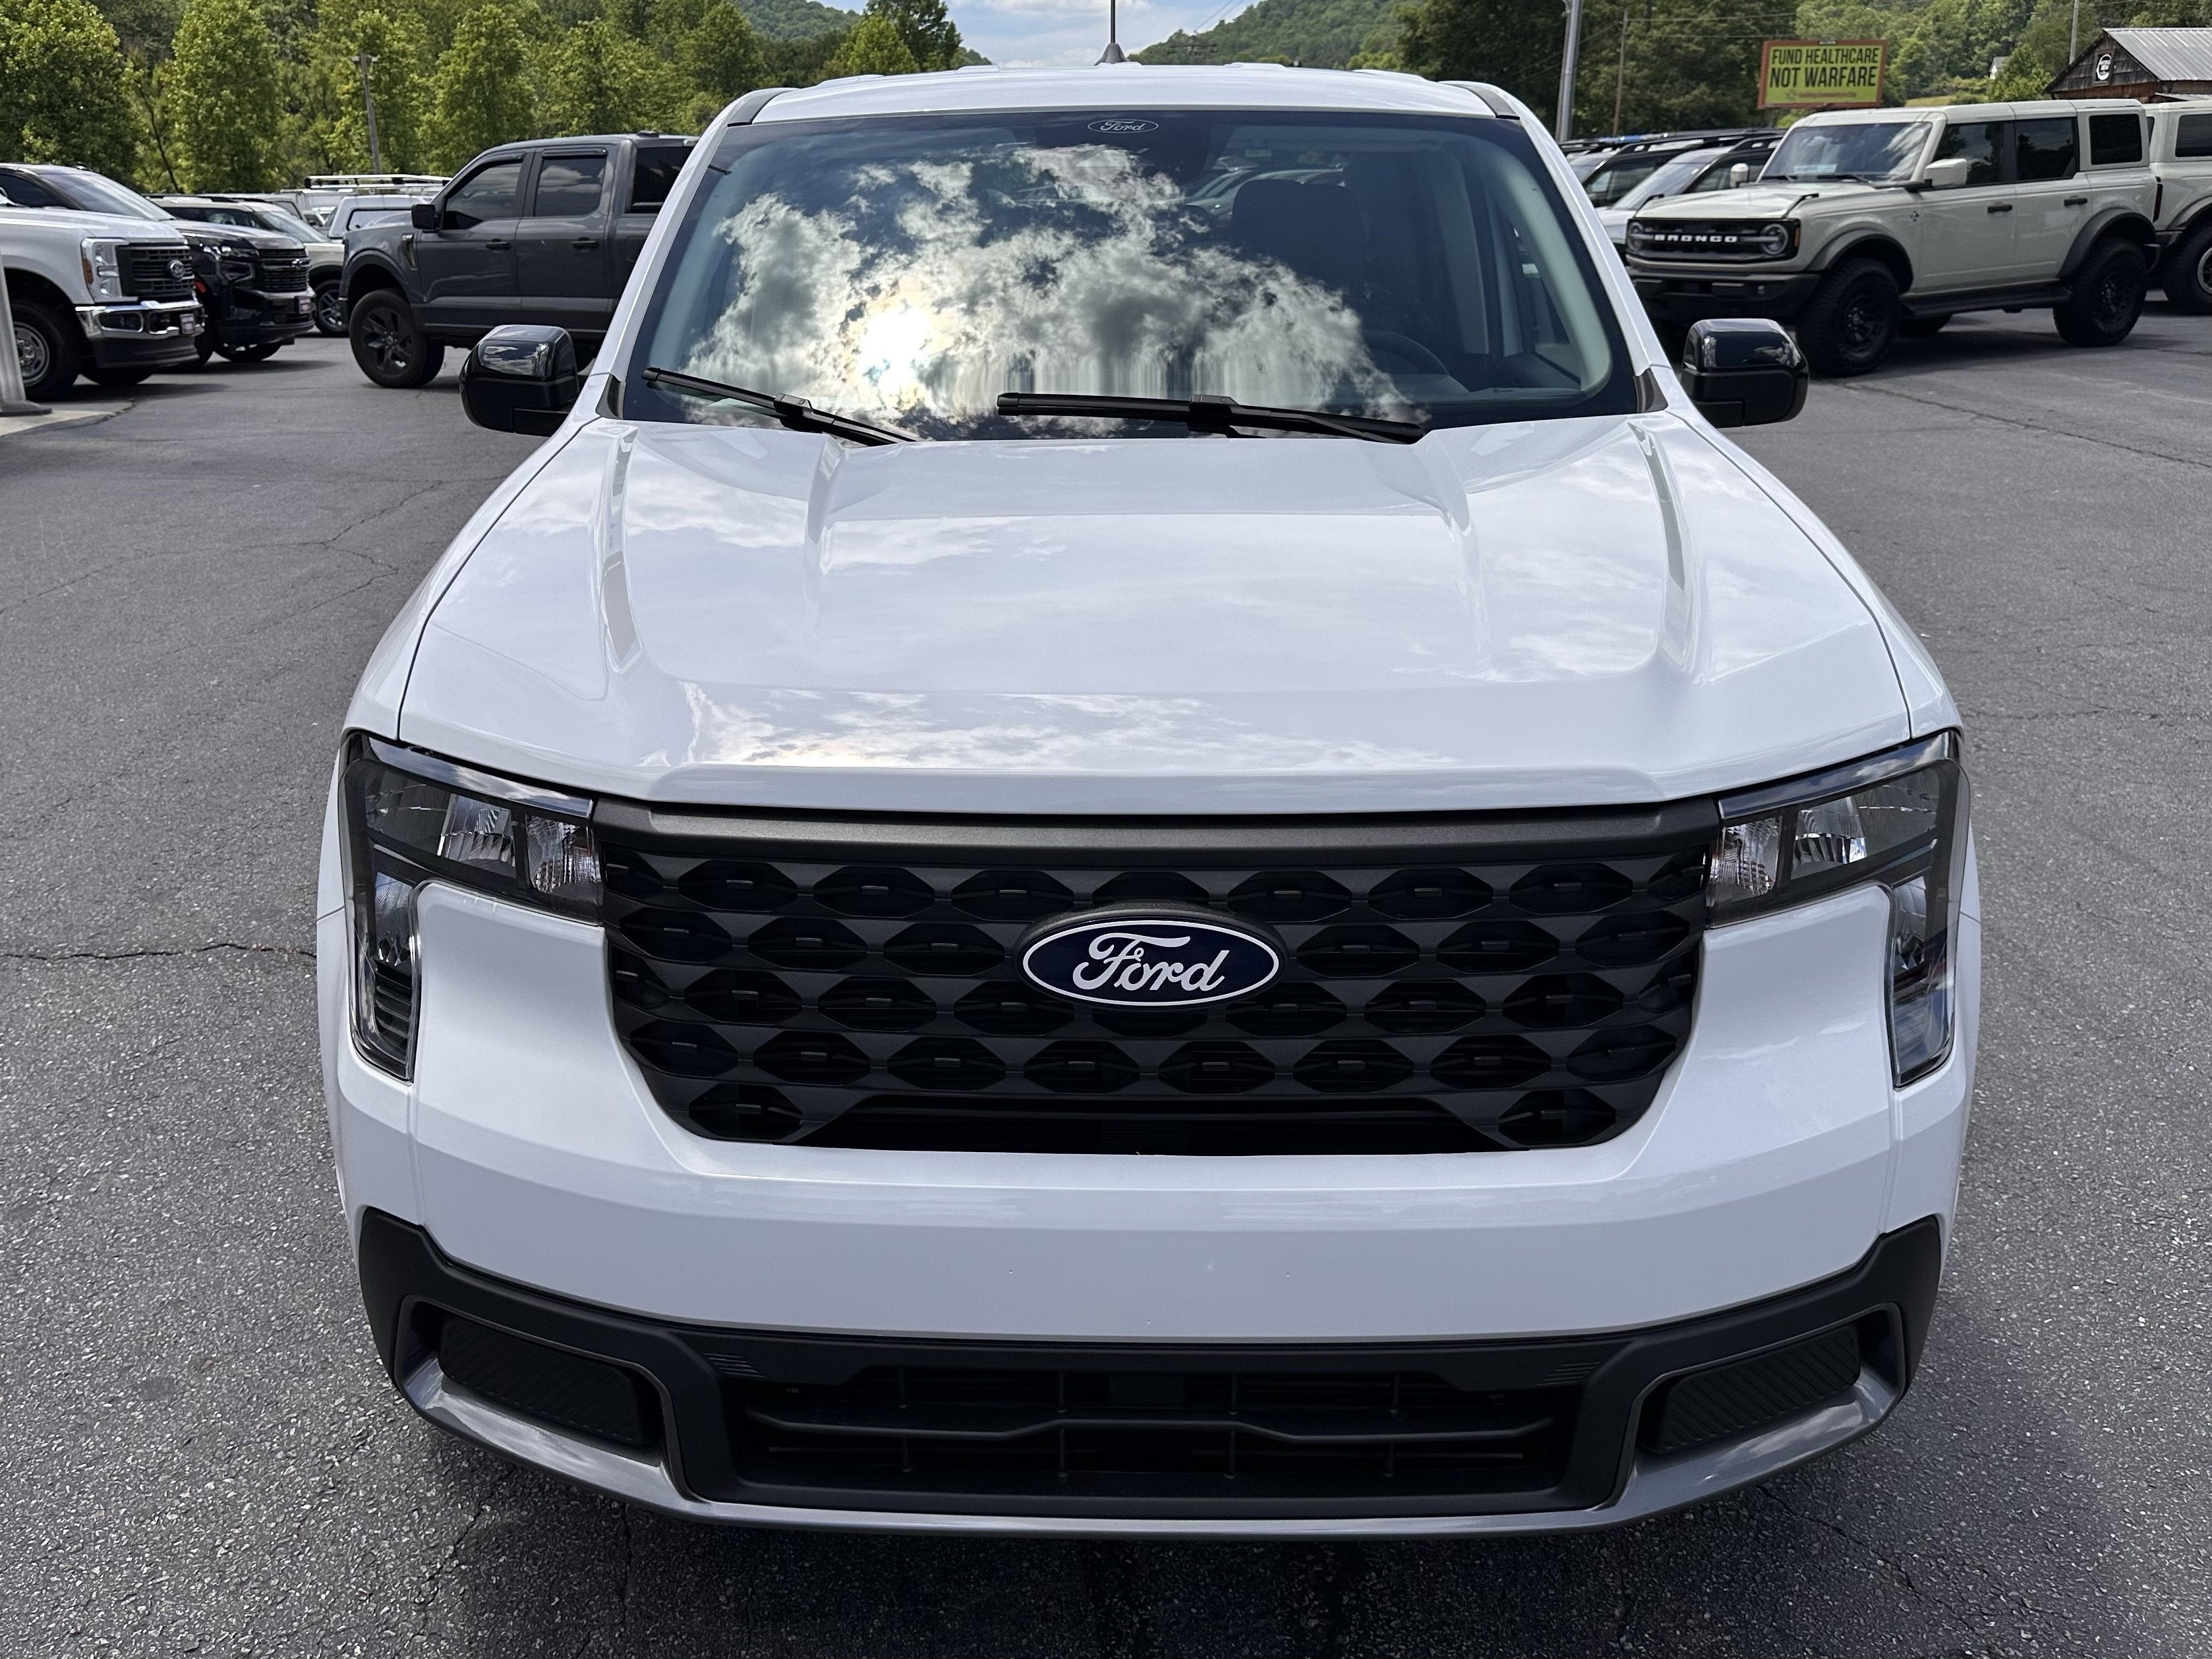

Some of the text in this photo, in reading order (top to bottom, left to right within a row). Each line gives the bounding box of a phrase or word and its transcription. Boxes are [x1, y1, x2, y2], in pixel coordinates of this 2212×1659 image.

[1772, 47, 1880, 65] FUND HEALTHCARE
[1770, 67, 1877, 88] NOT WARFARE
[1099, 121, 1146, 131] Ford
[1654, 234, 1738, 243] BRONCO
[1072, 933, 1230, 991] Ford
